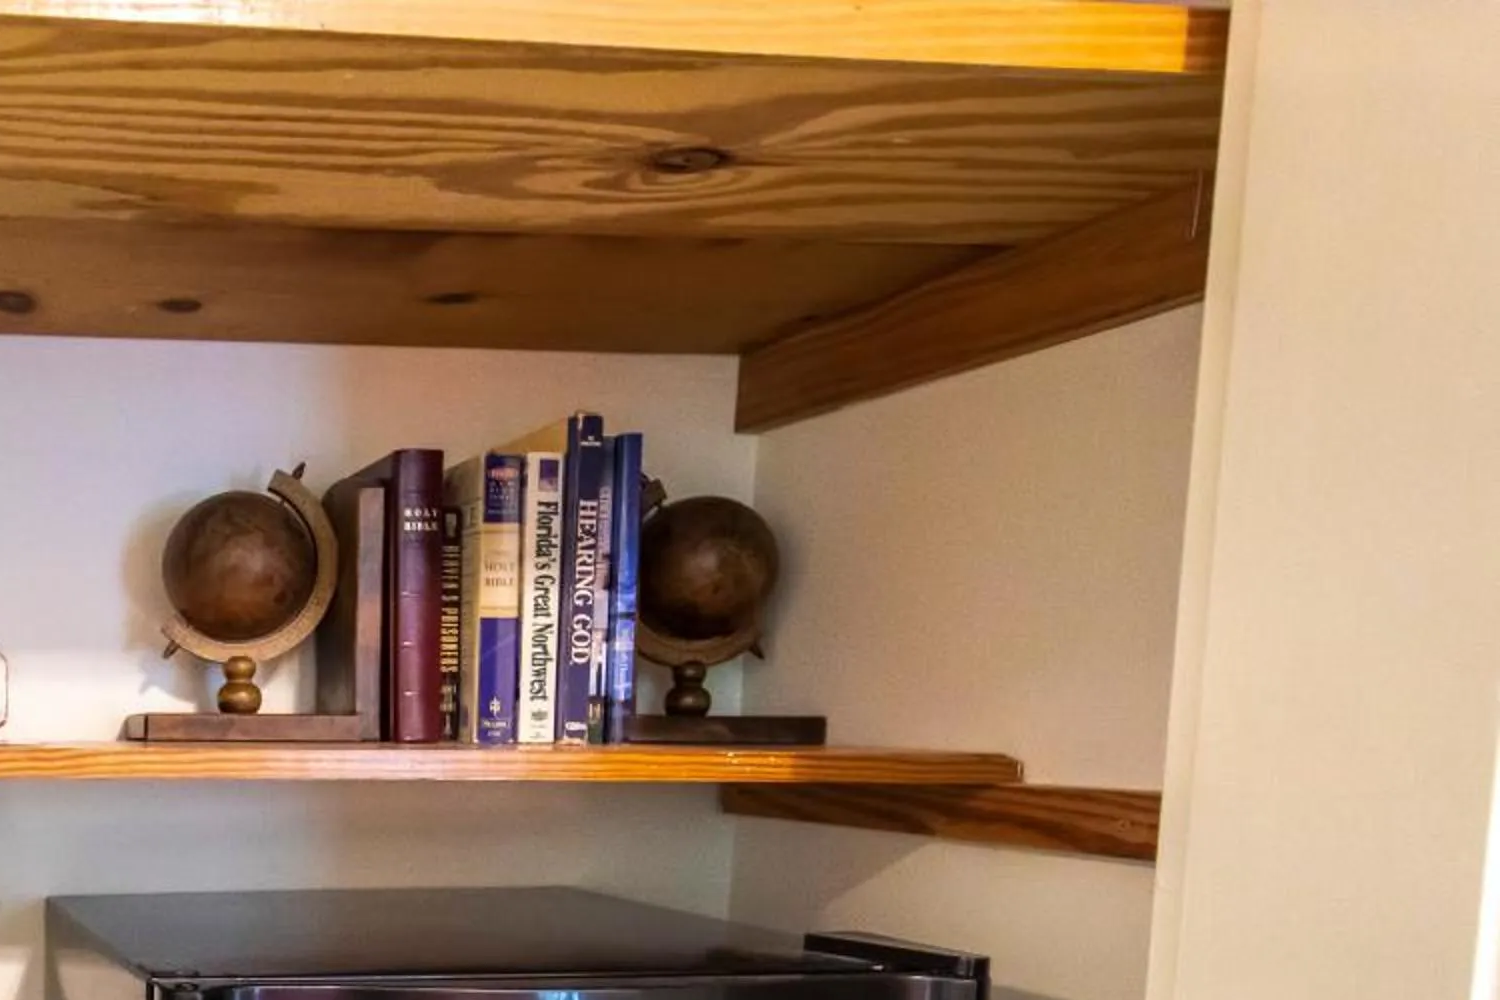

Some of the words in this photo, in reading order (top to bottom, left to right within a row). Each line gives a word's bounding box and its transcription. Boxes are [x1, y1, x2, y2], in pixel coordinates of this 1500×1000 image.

[403, 508, 438, 518] HOLY
[403, 521, 438, 531] BIBLE
[534, 501, 559, 570] Florida's
[573, 499, 599, 606] HEARING
[484, 561, 515, 572] HOLY
[484, 577, 515, 588] BIBLE
[533, 574, 556, 617] Great
[571, 613, 593, 665] GOD
[529, 622, 555, 701] Northwest
